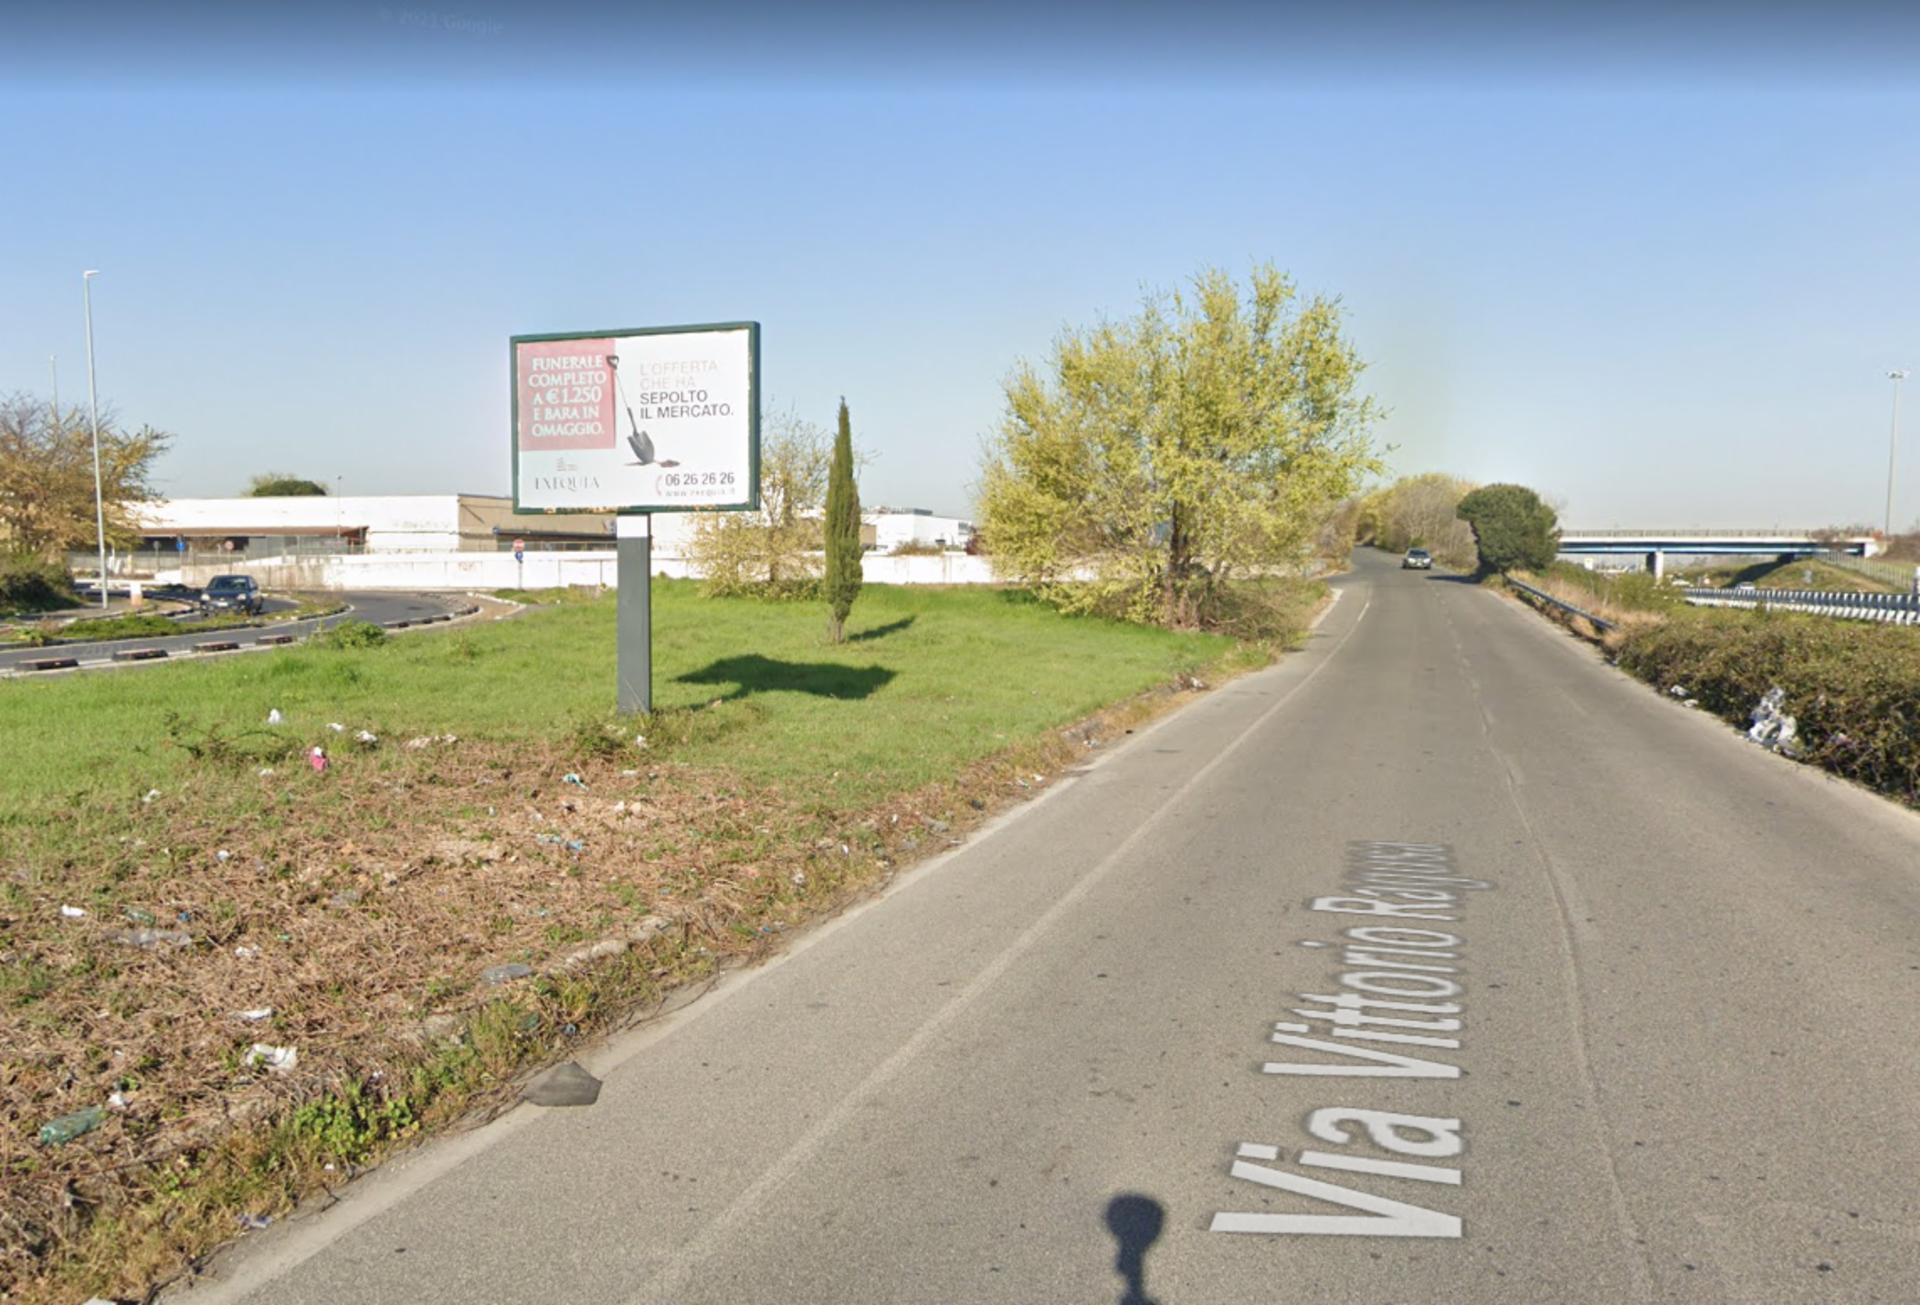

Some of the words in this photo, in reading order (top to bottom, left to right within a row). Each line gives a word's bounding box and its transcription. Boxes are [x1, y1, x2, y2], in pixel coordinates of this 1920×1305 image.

[532, 354, 603, 371] FUNERALE
[528, 370, 607, 388] COMPLETO
[640, 378, 673, 391] CHE
[675, 376, 696, 390] HA
[532, 392, 543, 405] A
[640, 389, 708, 405] SEPOLTO
[533, 407, 541, 421] E
[544, 406, 580, 421] BARA
[582, 405, 600, 418] IN
[640, 407, 653, 419] IL
[657, 403, 734, 418] MERCATO.
[665, 473, 680, 486] 06
[683, 472, 698, 485] 26
[702, 472, 717, 485] 26
[720, 472, 735, 485] 26
